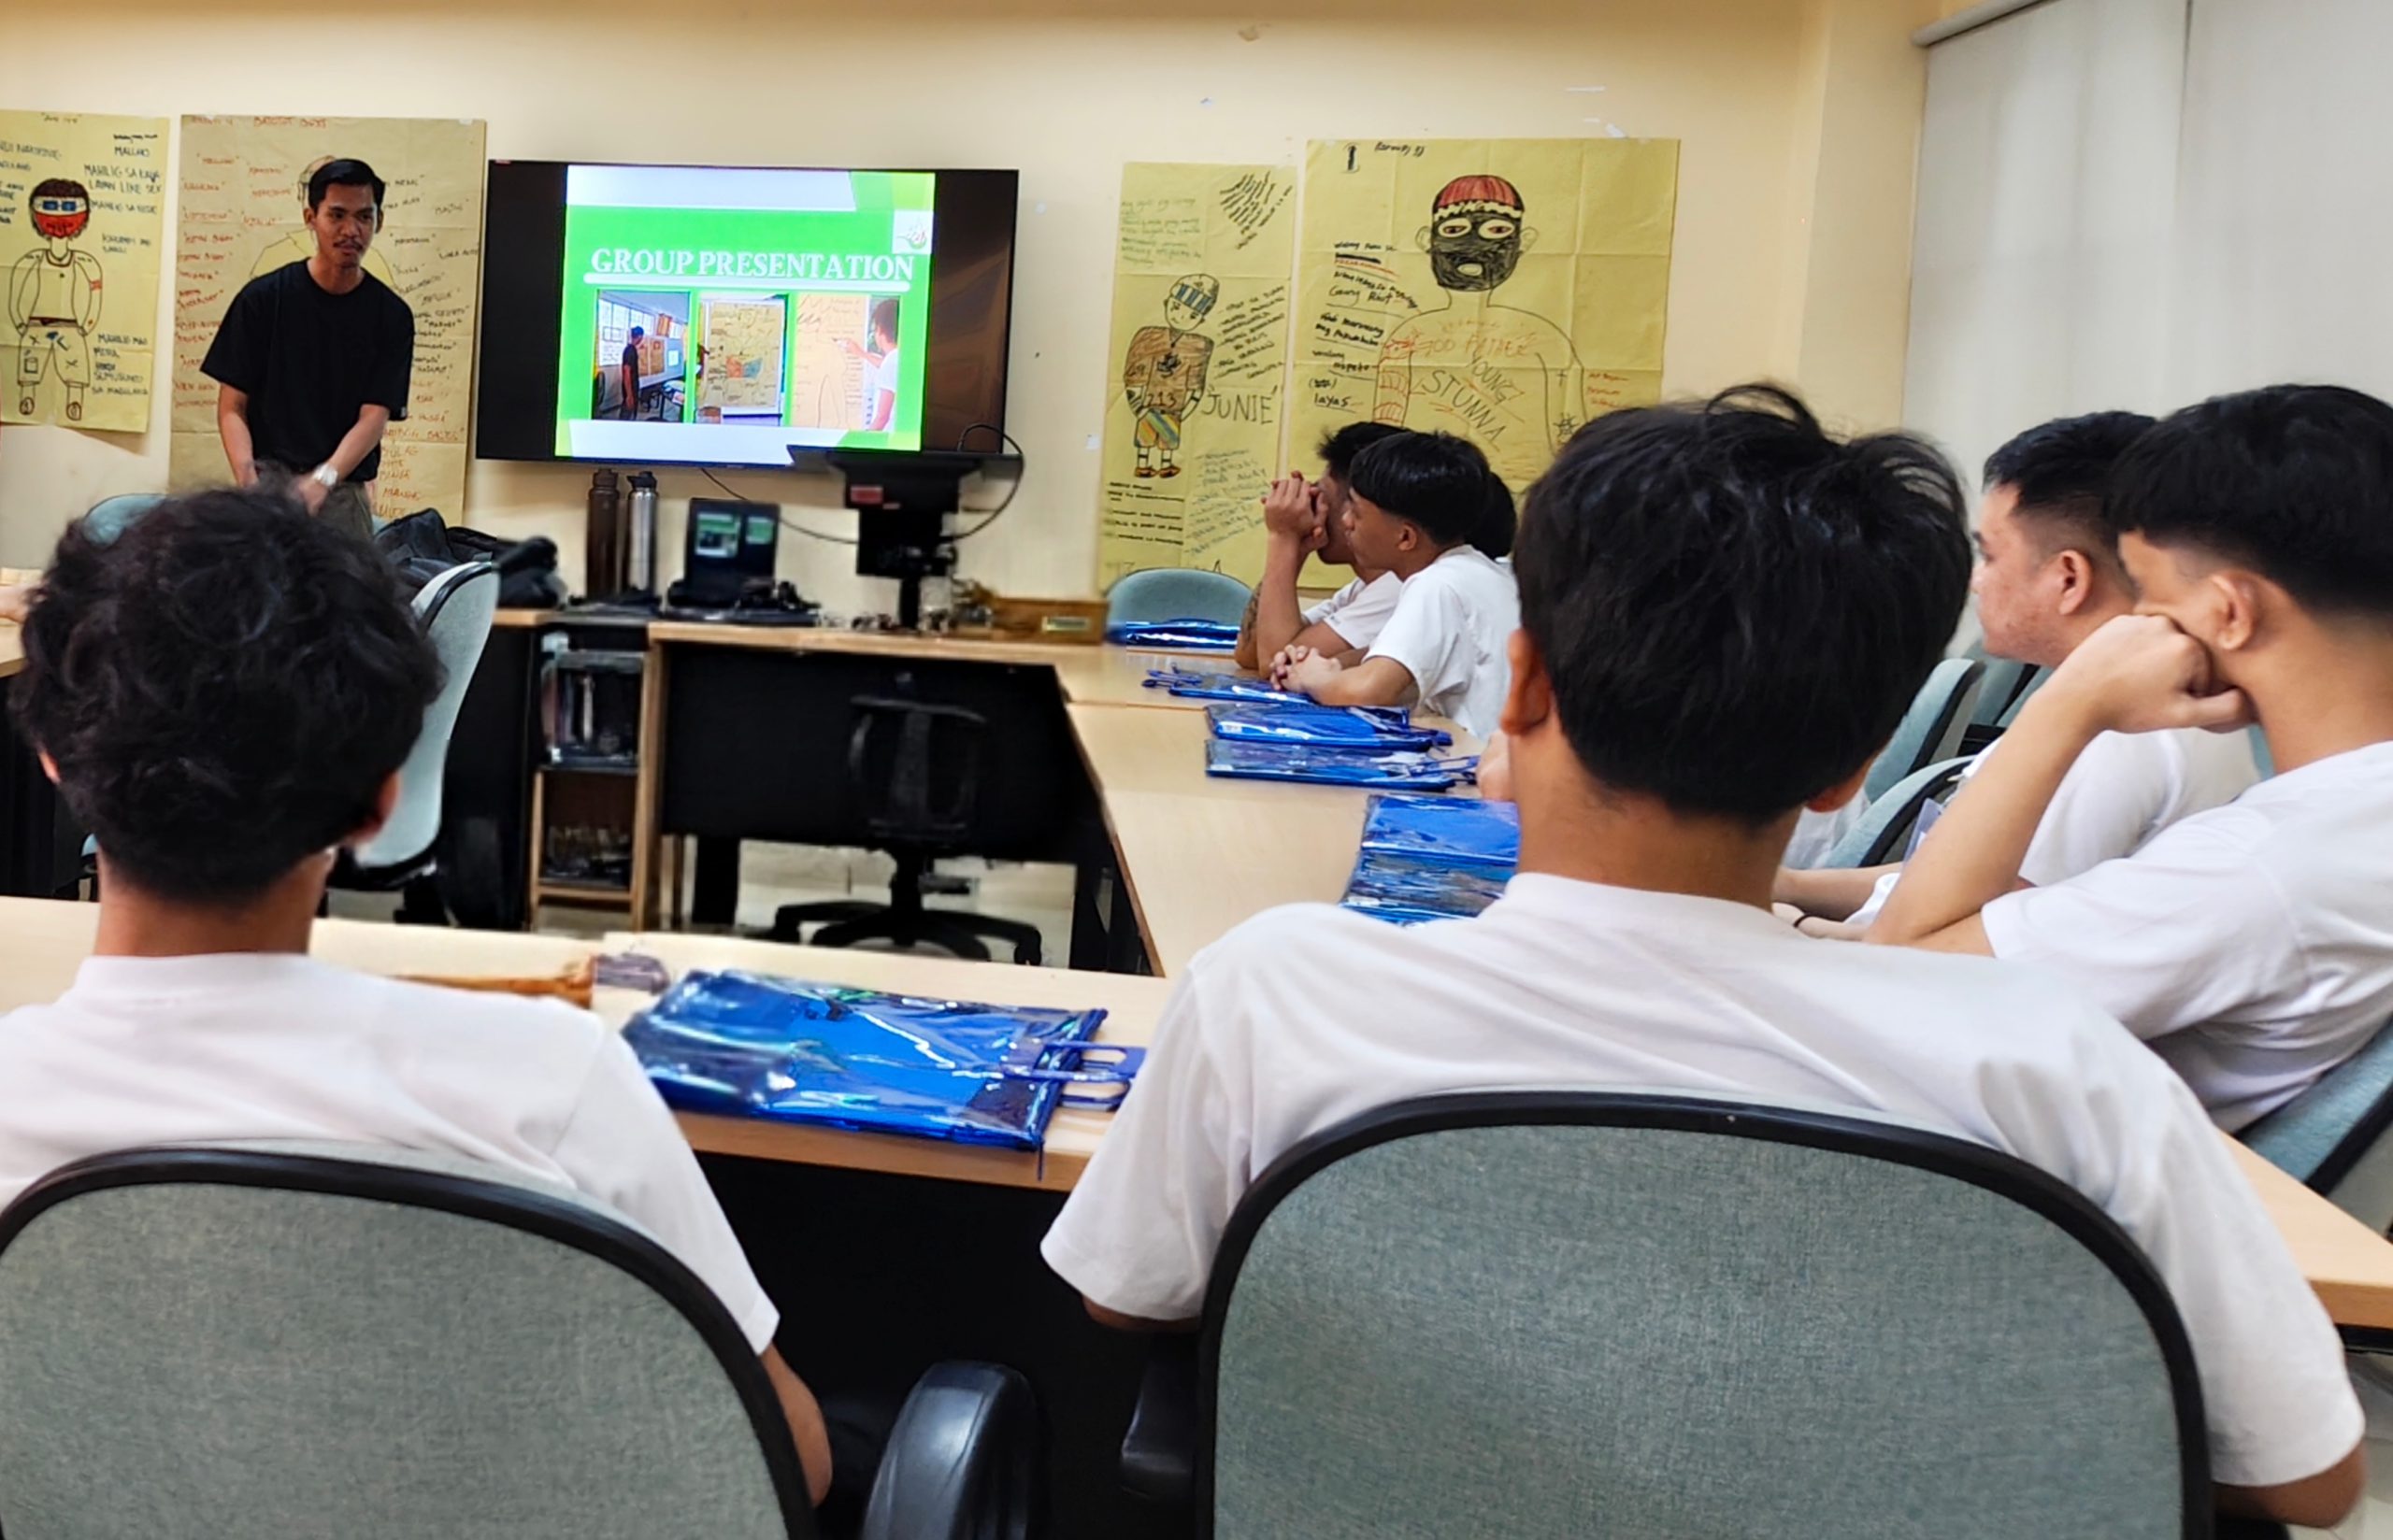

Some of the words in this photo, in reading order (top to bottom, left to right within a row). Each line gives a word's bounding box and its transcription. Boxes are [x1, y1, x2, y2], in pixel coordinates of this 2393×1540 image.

[591, 249, 694, 275] GROUP
[698, 252, 915, 281] PRESENTATION
[1421, 369, 1507, 443] STUNNA
